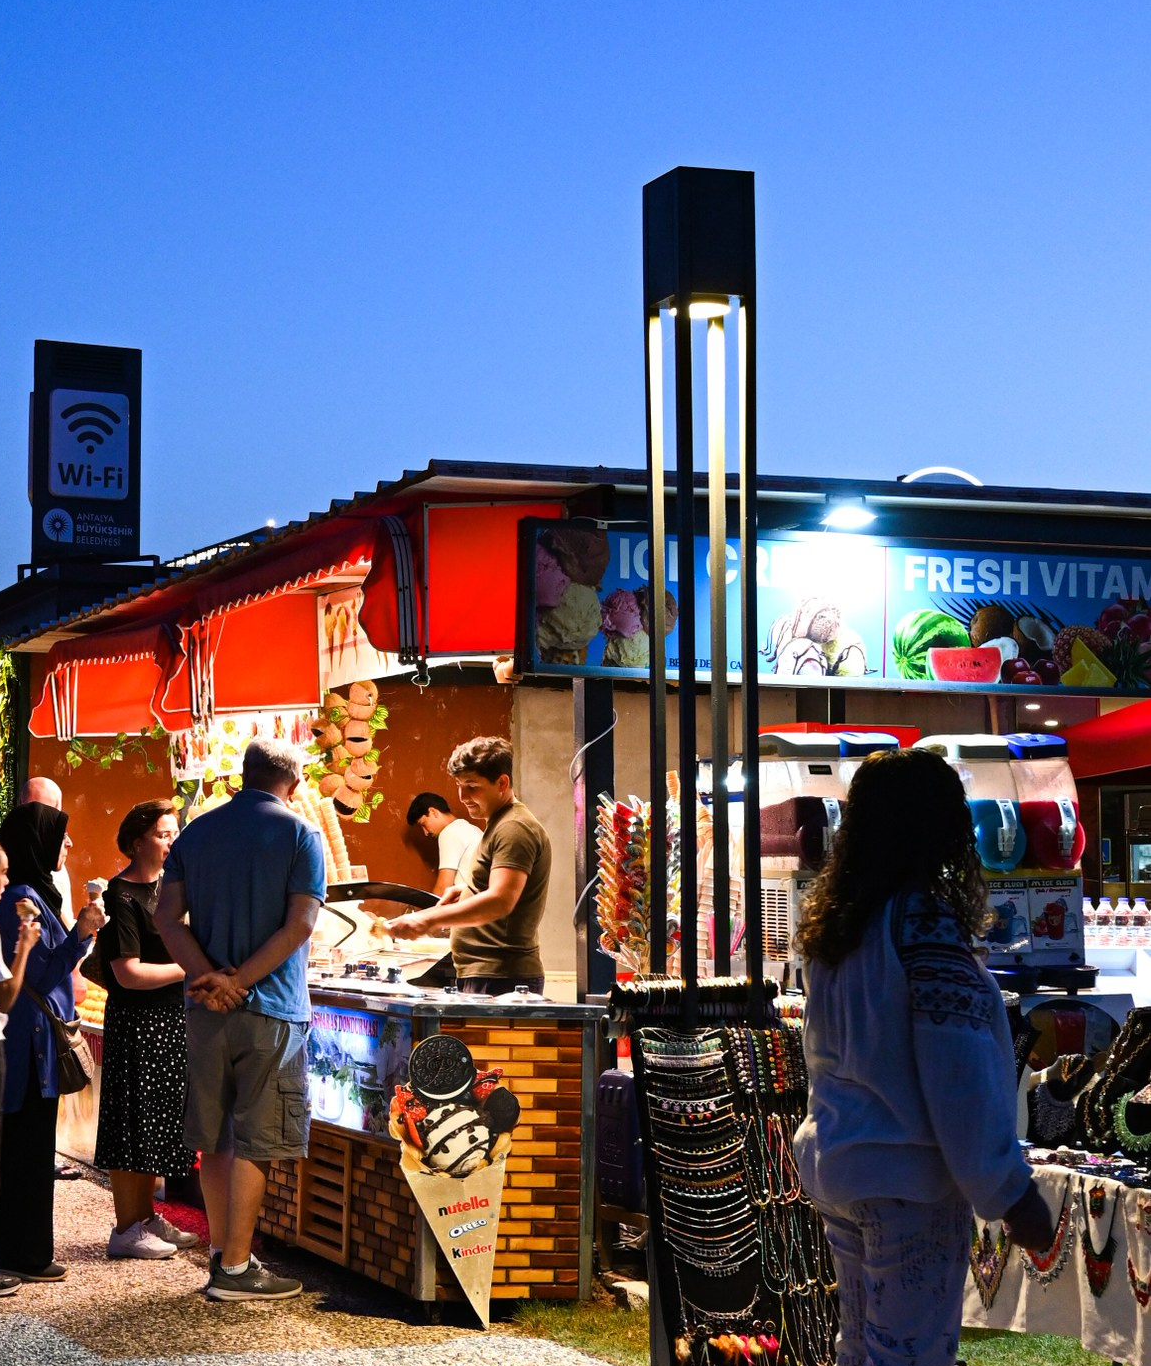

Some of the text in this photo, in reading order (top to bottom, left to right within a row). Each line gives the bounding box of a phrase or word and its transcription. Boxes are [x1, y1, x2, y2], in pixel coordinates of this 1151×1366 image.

[57, 462, 123, 489] Wi-Fi
[76, 513, 115, 523] ANTALYA
[904, 554, 1029, 596] FRESH
[438, 1196, 489, 1216] nutella
[449, 1219, 487, 1238] OREO
